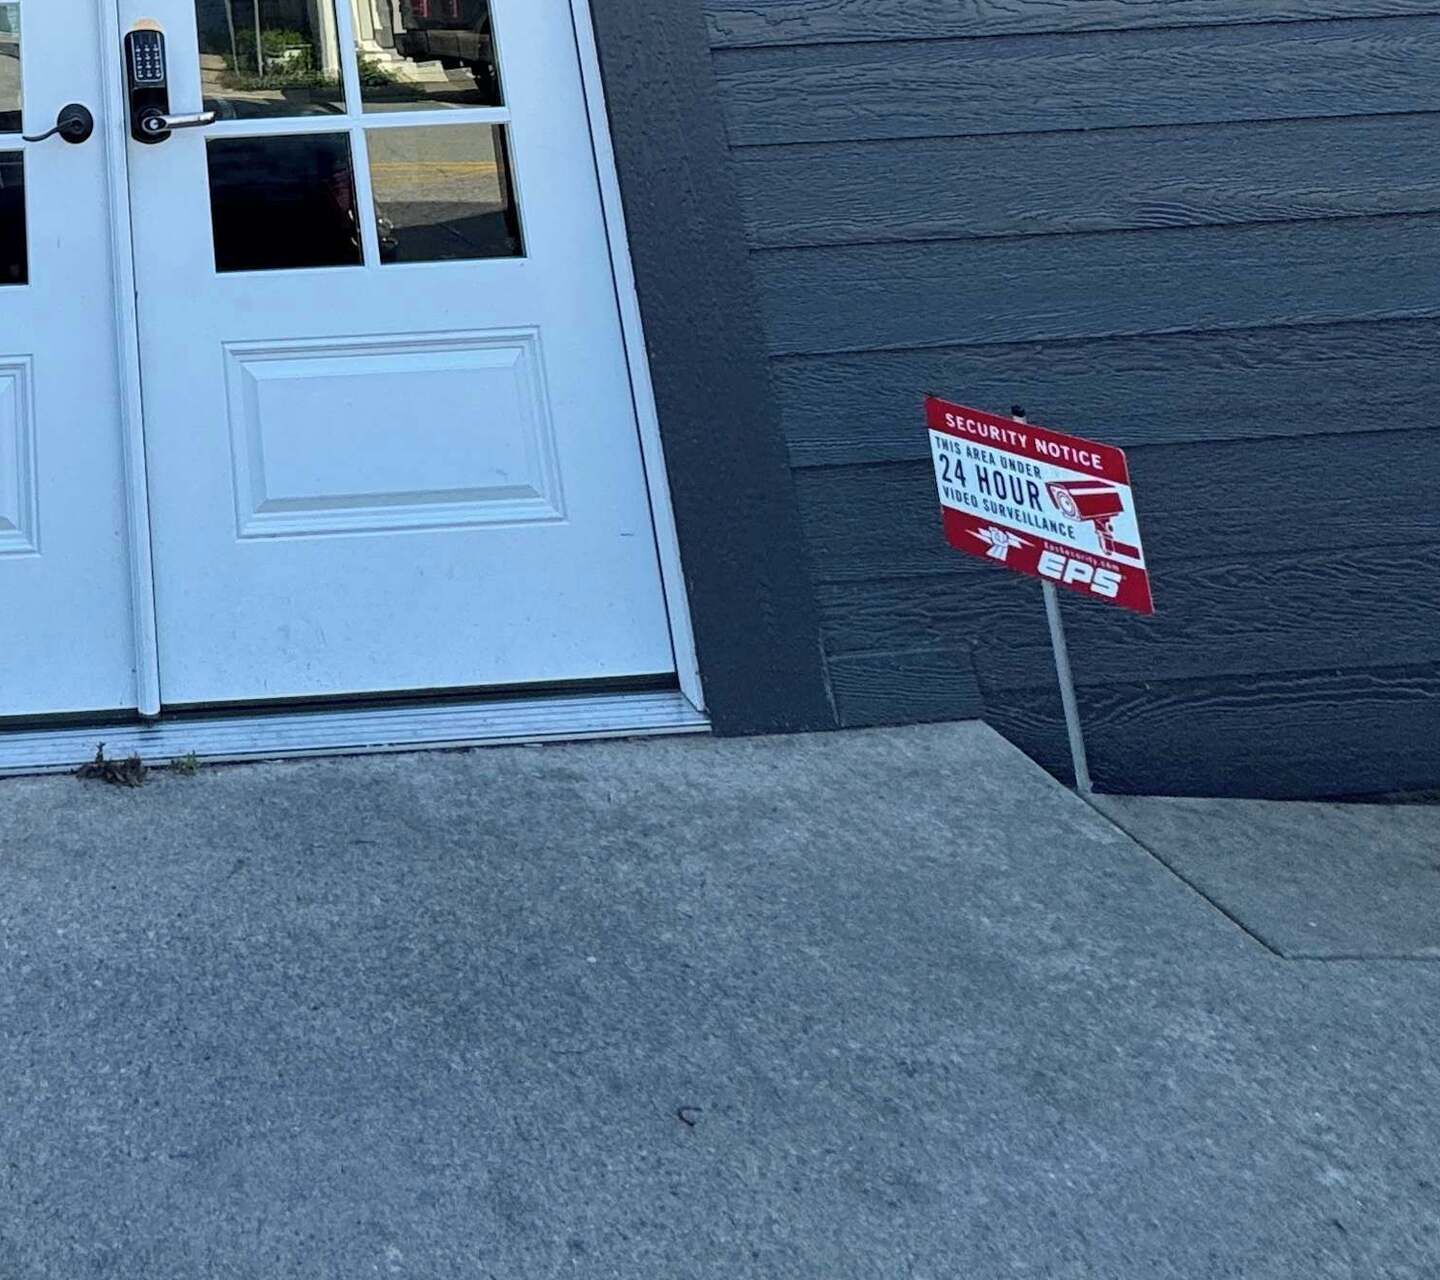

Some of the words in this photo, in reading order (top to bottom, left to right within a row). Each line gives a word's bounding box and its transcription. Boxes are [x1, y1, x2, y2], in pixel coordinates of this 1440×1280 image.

[935, 436, 961, 455] THIS
[966, 446, 996, 465] AREA
[1000, 455, 1042, 479] UNDER
[945, 413, 1027, 448] SECURITY
[1034, 438, 1104, 470] NOTICE
[939, 454, 966, 488] 24
[975, 464, 1043, 512] HOUR
[942, 485, 978, 508] VIDEO
[982, 498, 1076, 539] SURVEILLANCE
[1038, 550, 1122, 598] EPS
